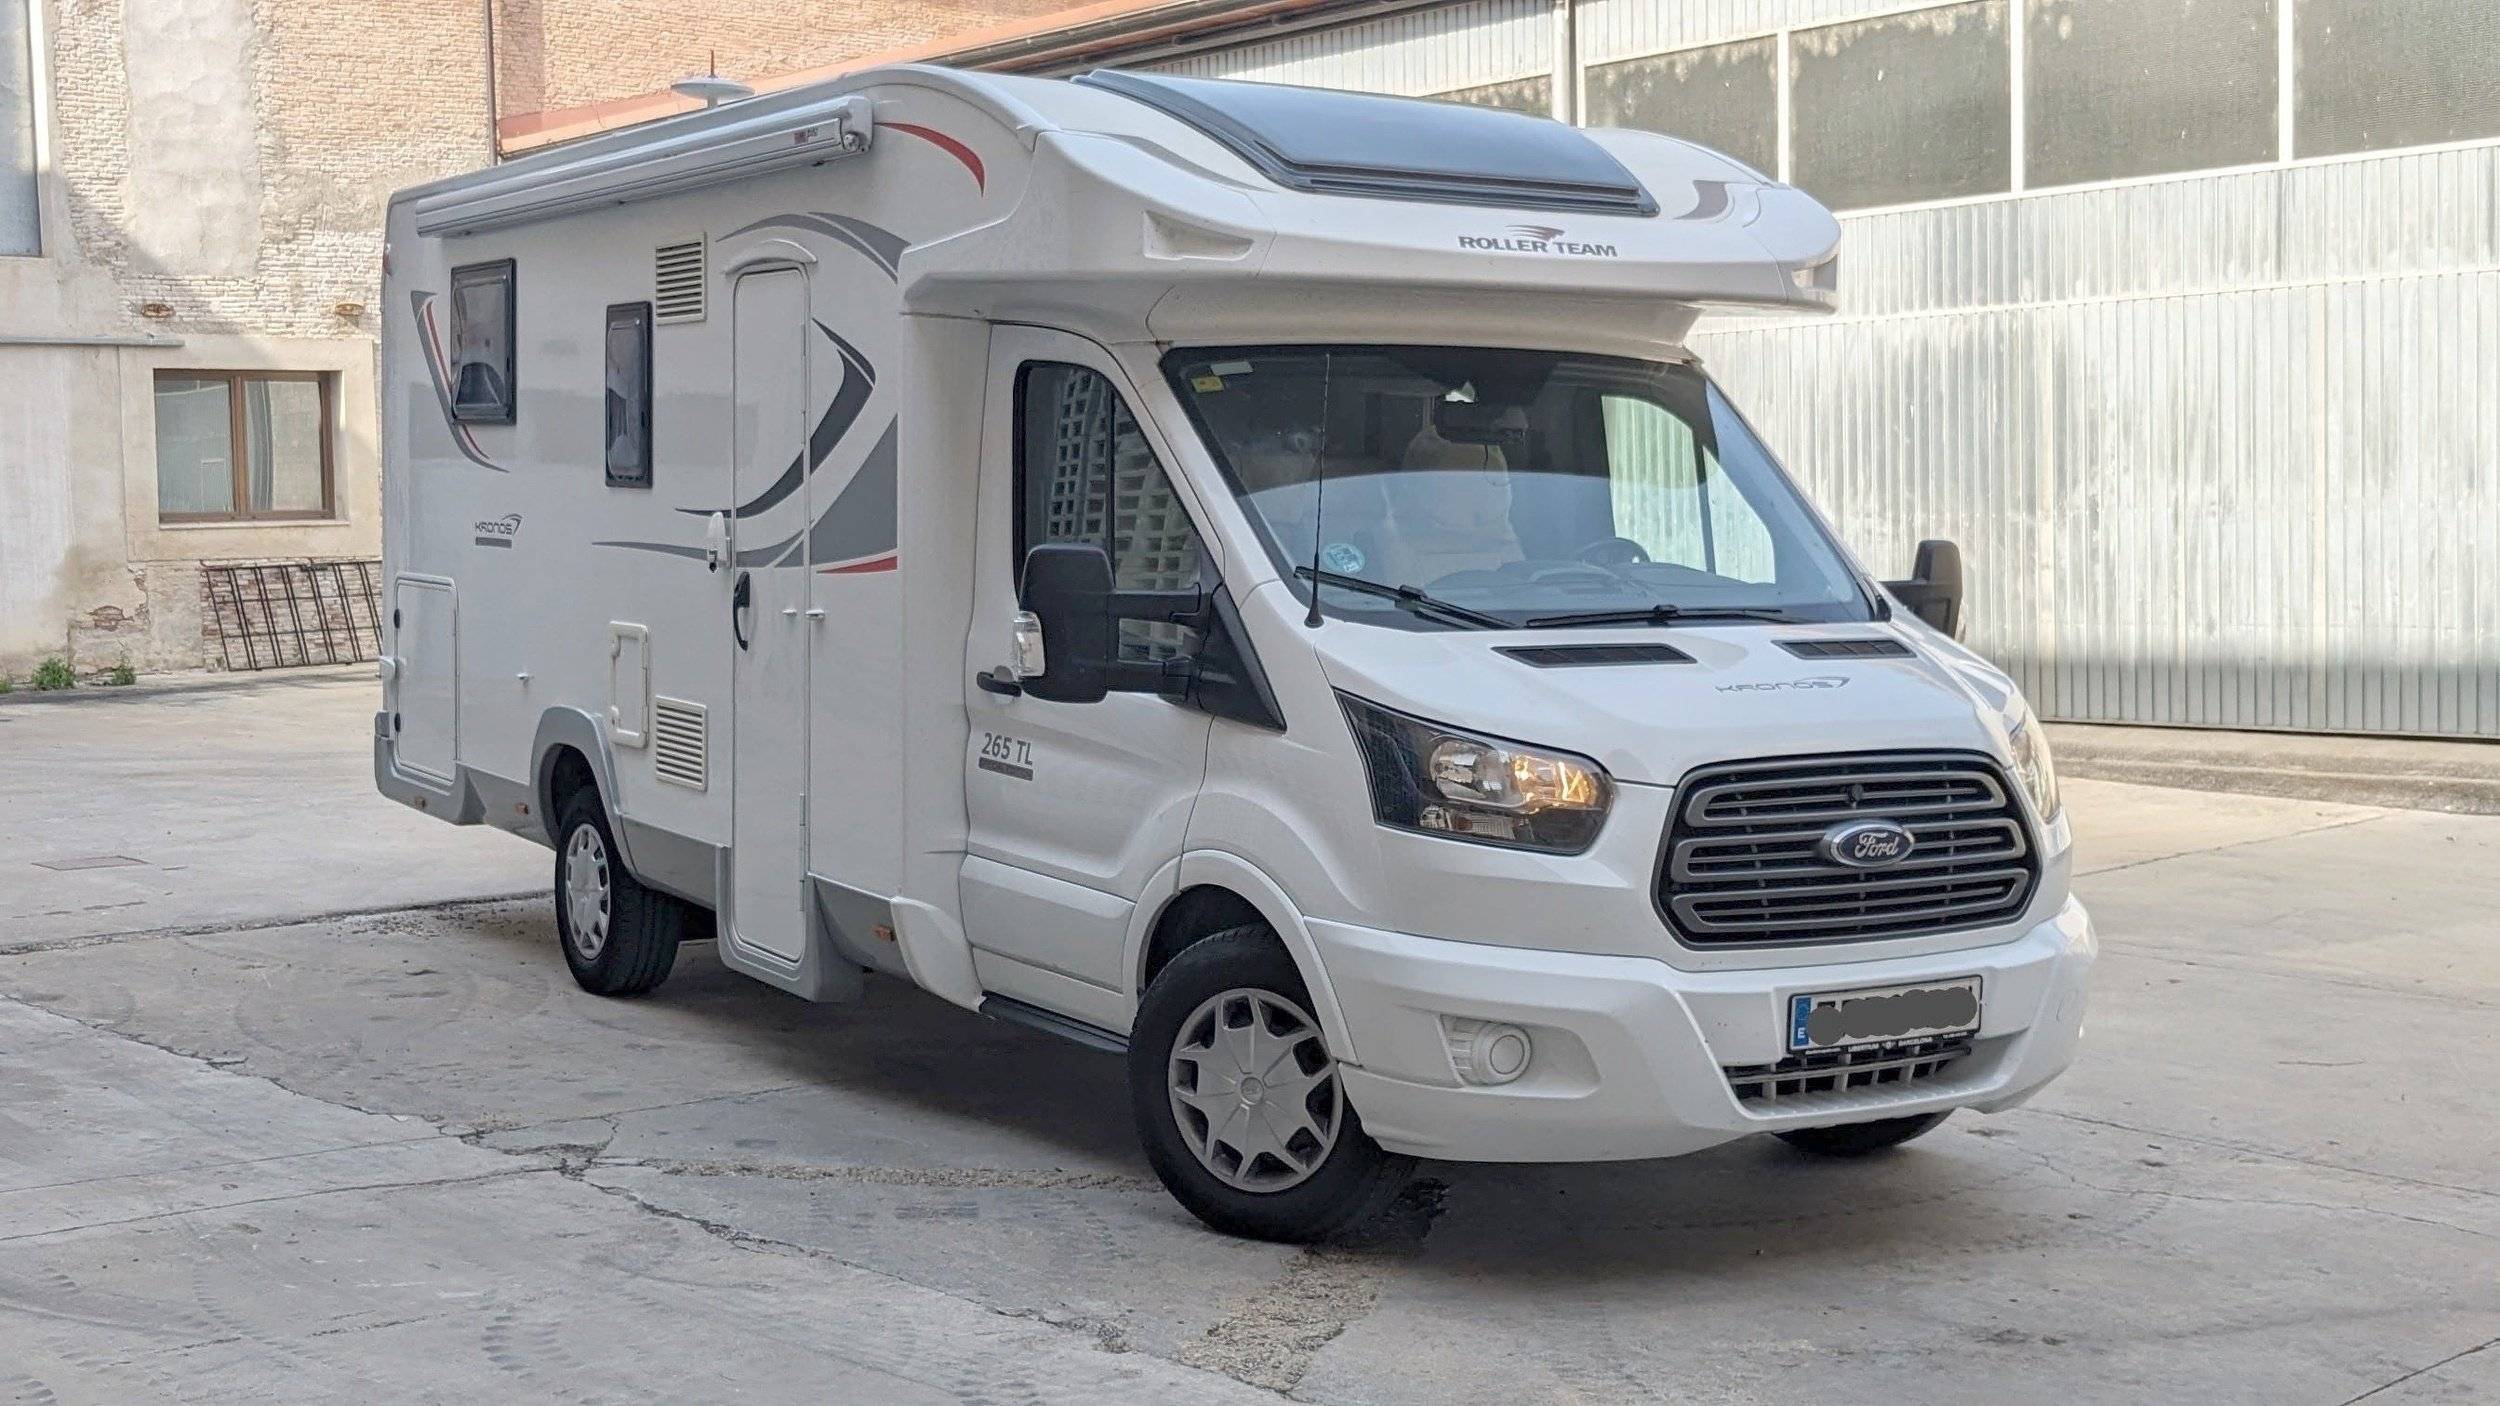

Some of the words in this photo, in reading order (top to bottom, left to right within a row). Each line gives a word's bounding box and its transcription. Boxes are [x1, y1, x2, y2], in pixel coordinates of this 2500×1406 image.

[1458, 235, 1549, 253] ROLLER
[1552, 242, 1618, 258] TEAM
[981, 731, 1012, 760] 265
[1016, 739, 1033, 766] TL
[1853, 831, 1900, 859] Ford
[1797, 1027, 1807, 1039] E
[1897, 1036, 1934, 1047] BARCELONA
